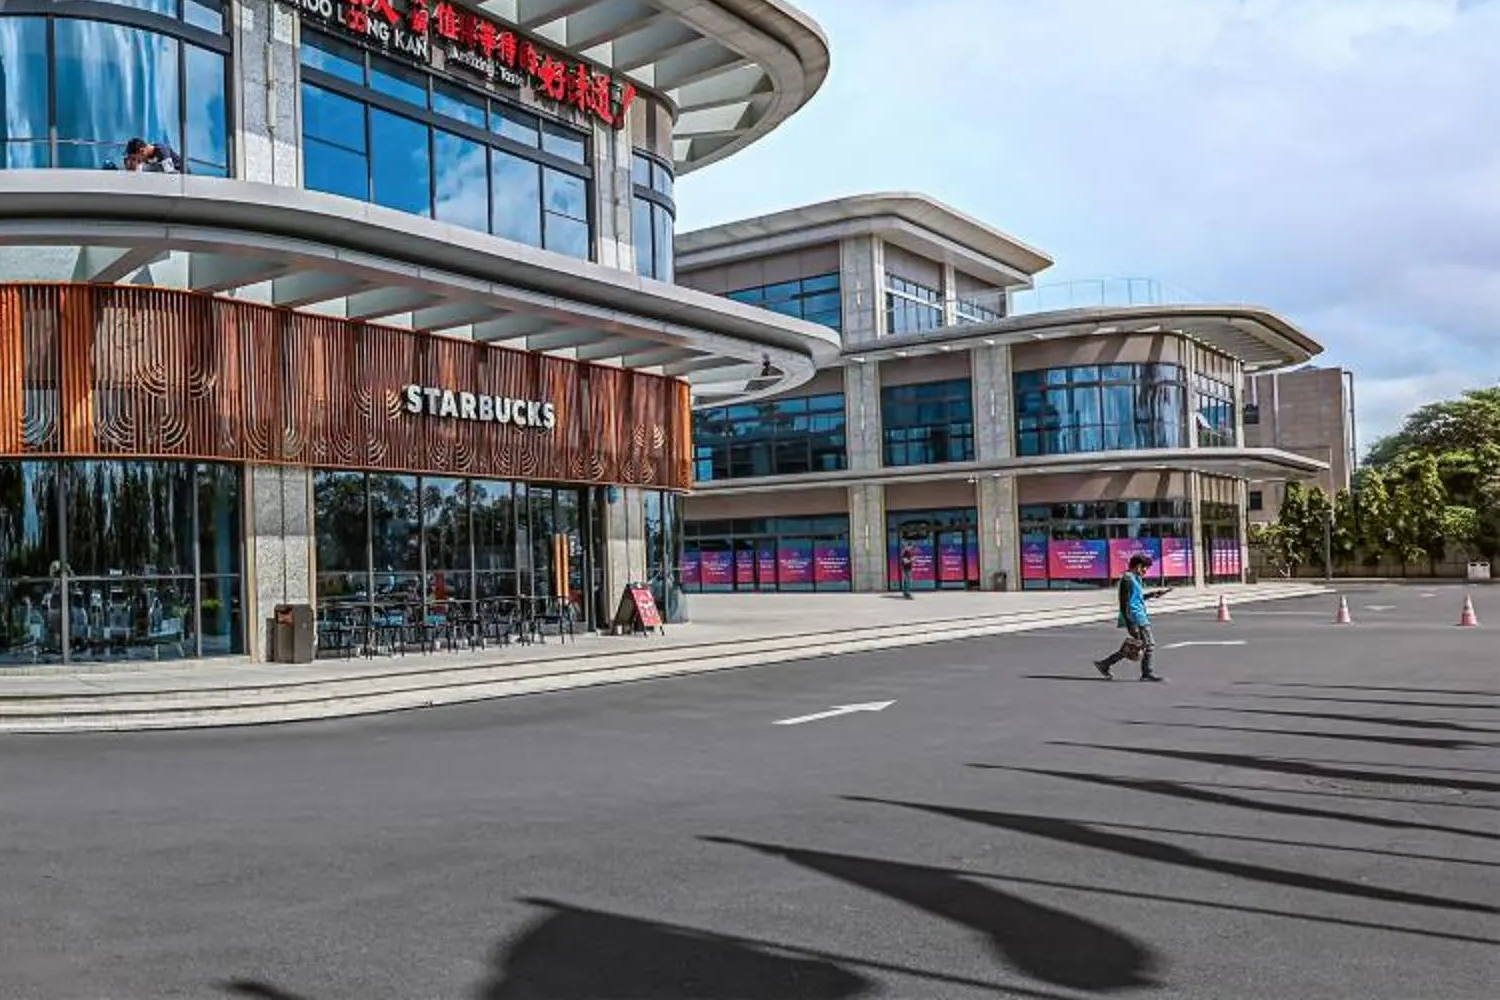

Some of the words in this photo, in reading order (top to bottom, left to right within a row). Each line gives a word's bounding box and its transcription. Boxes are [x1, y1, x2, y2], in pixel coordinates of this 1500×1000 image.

[337, 5, 390, 42] LOONG
[394, 28, 430, 62] KAN
[405, 384, 556, 430] STARBUCKS
